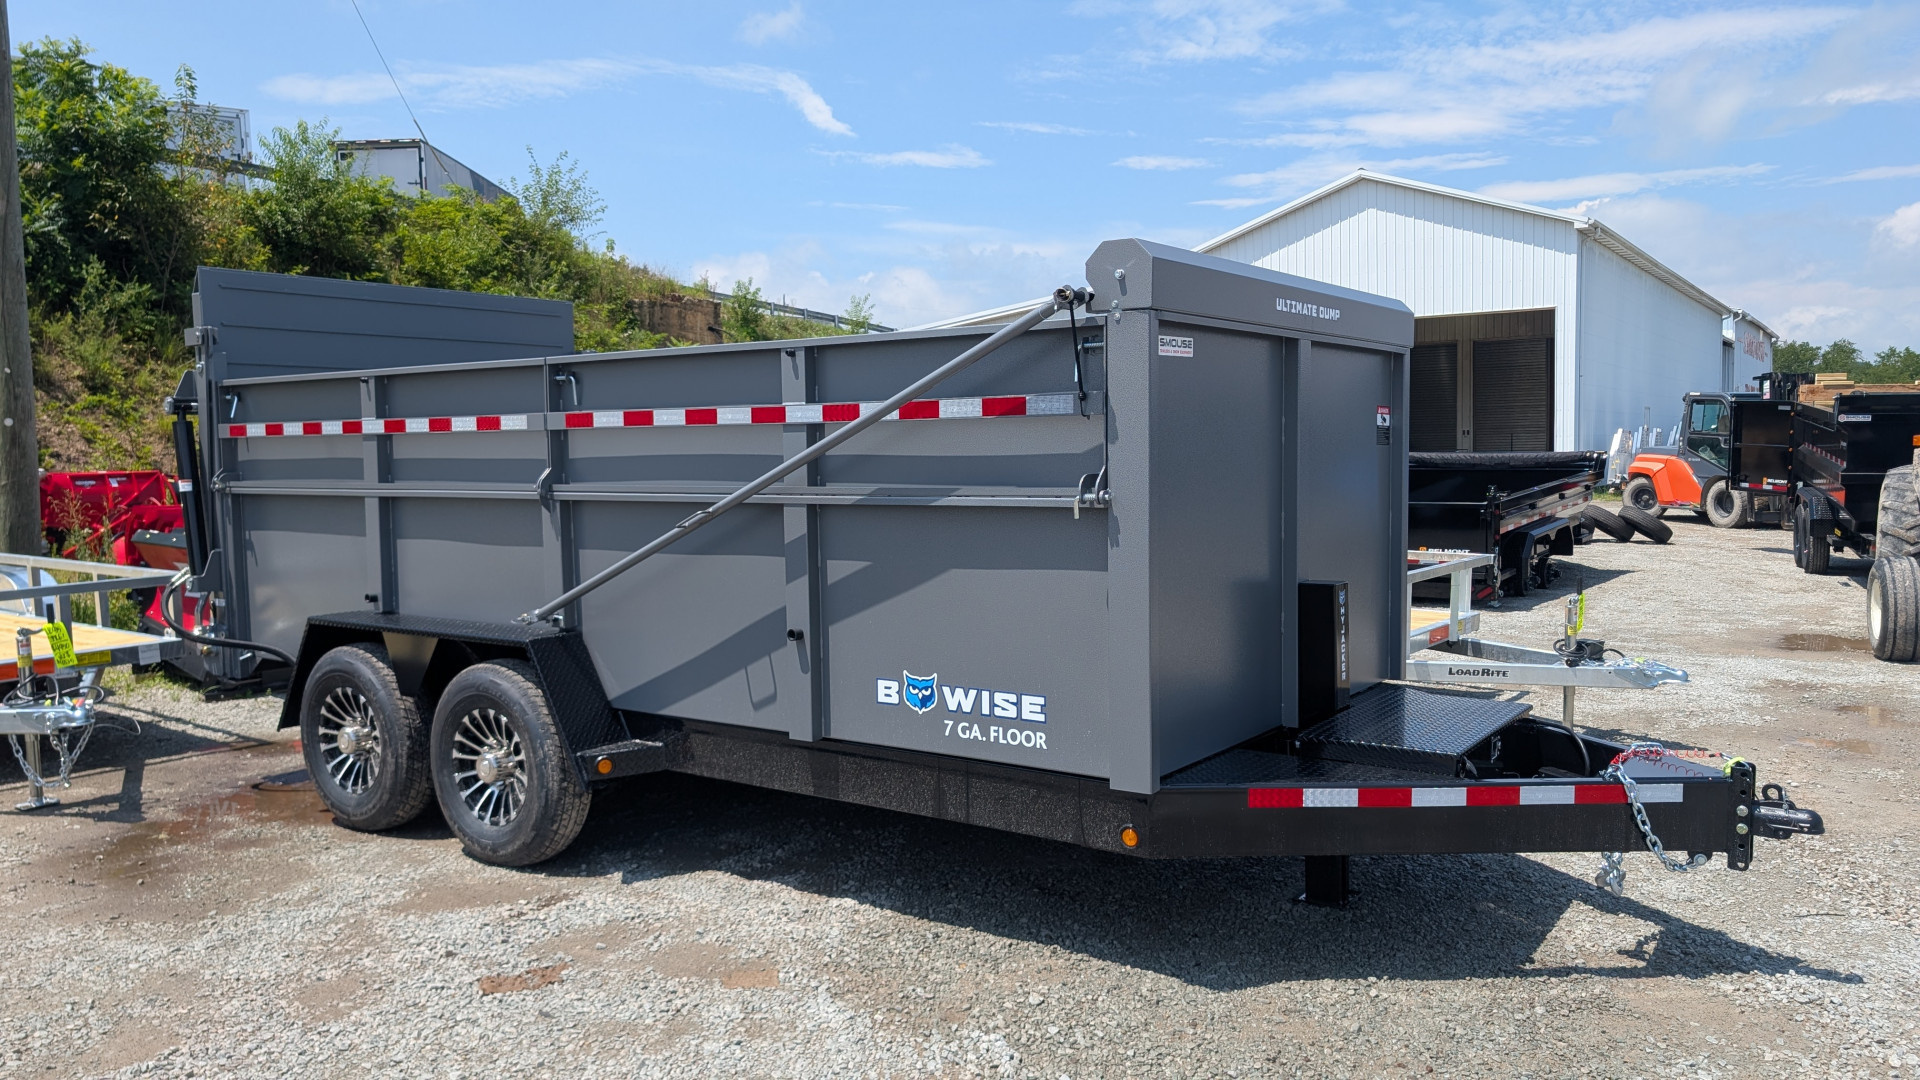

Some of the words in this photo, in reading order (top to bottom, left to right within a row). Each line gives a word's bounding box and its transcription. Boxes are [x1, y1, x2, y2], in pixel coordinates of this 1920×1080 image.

[1276, 297, 1318, 317] ULTIMATE
[1319, 306, 1341, 321] DUMP
[1159, 337, 1193, 349] SMOUSE
[943, 720, 954, 736] 7
[957, 722, 986, 742] GA.
[990, 725, 1048, 750] FLOOR
